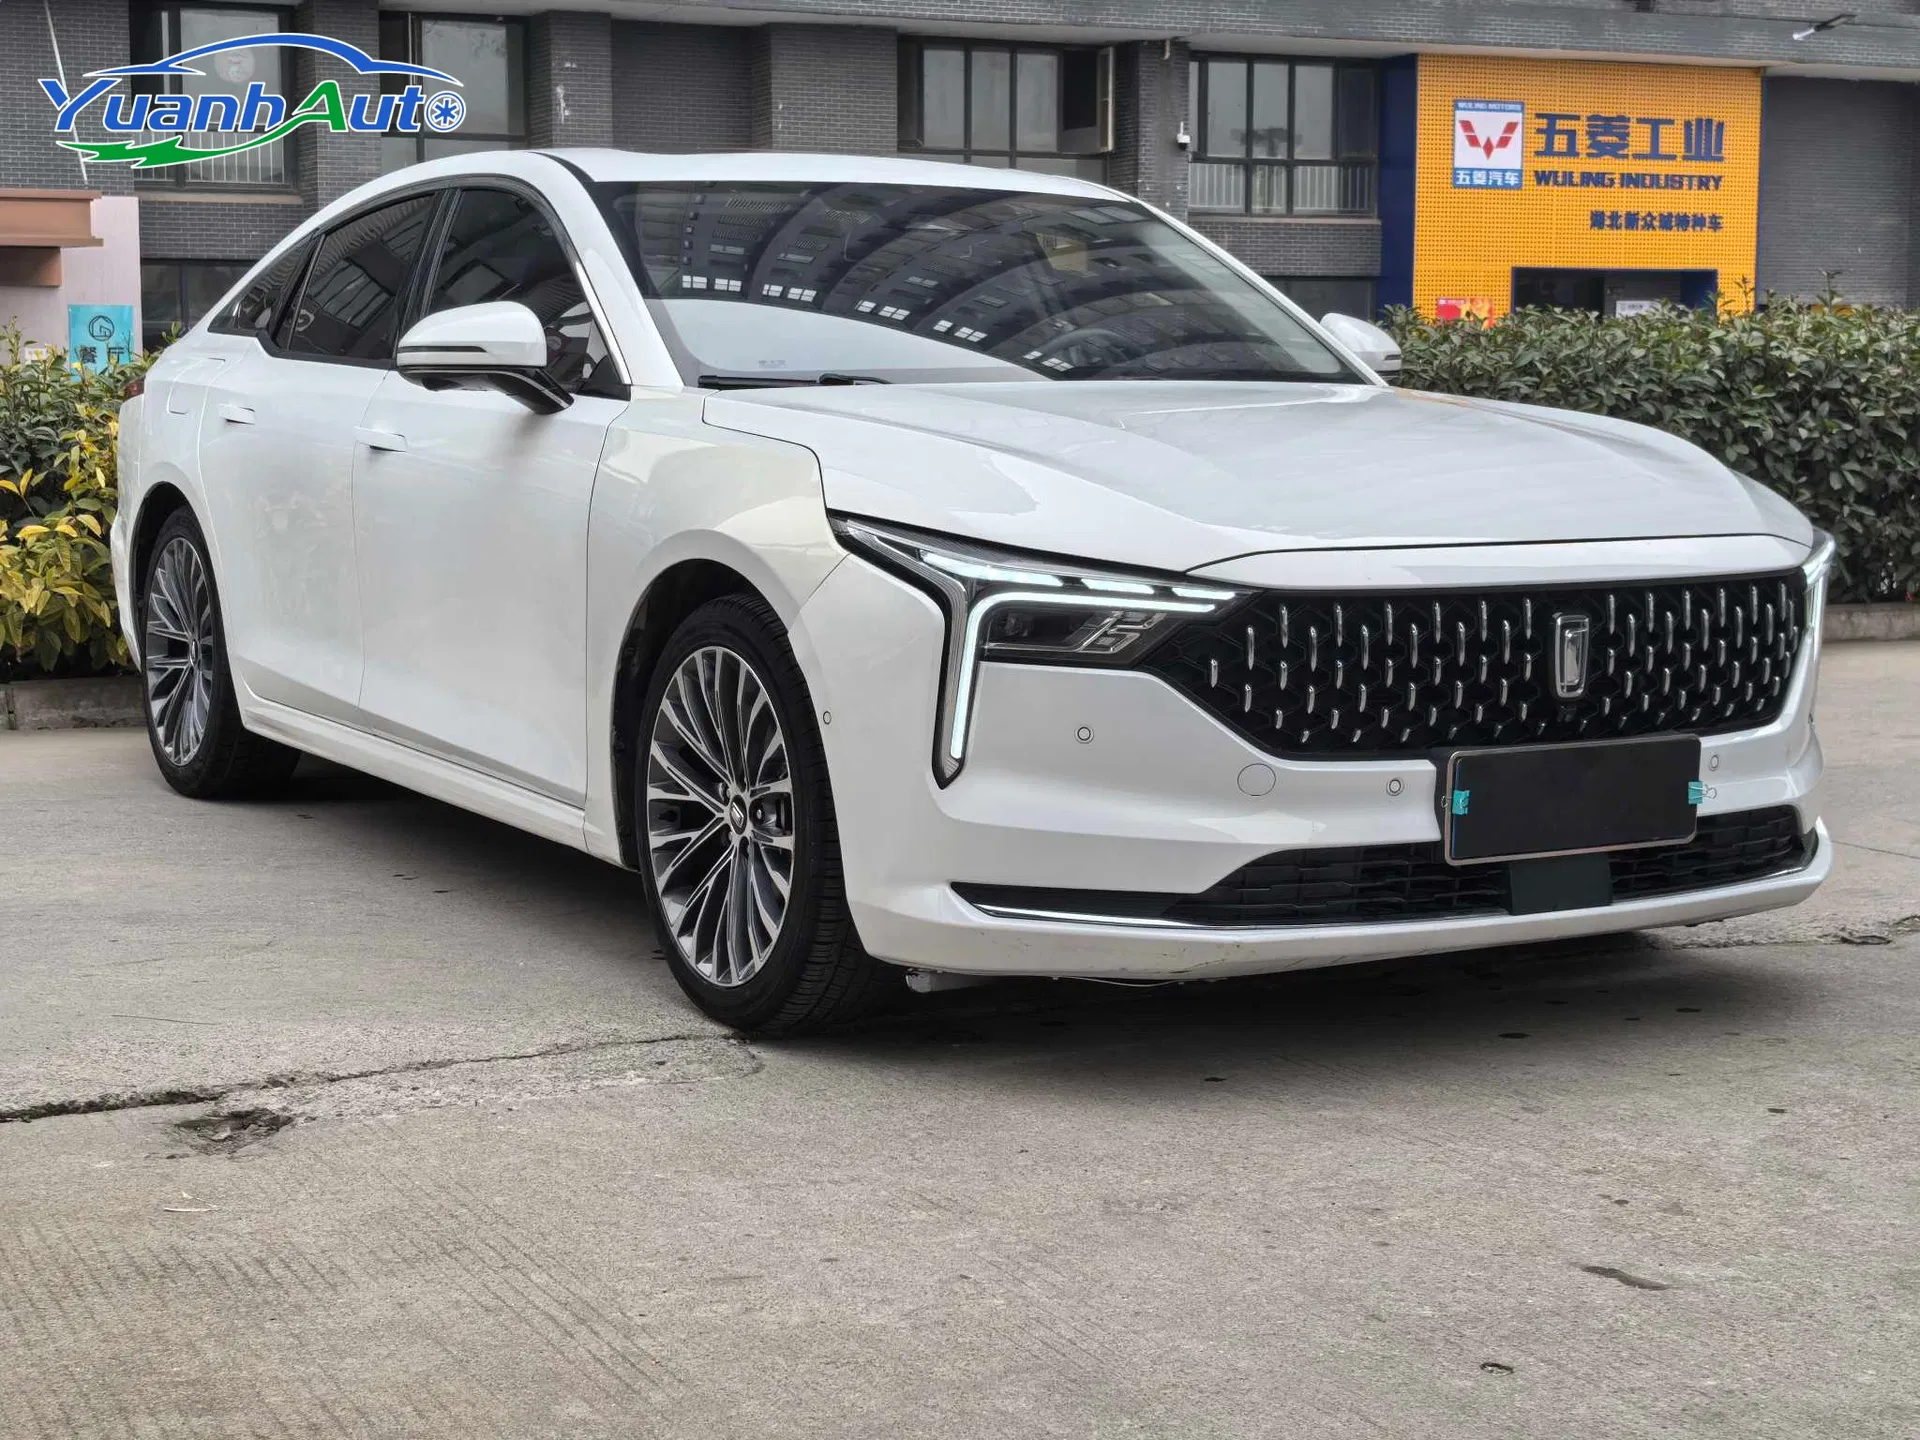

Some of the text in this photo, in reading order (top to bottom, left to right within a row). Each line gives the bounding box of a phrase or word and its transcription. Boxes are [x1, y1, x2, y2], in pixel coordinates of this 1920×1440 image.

[1534, 112, 1724, 162] 五菱工业
[1455, 170, 1520, 186] 五菱汽车
[1534, 170, 1723, 191] WULING INDUSTRY
